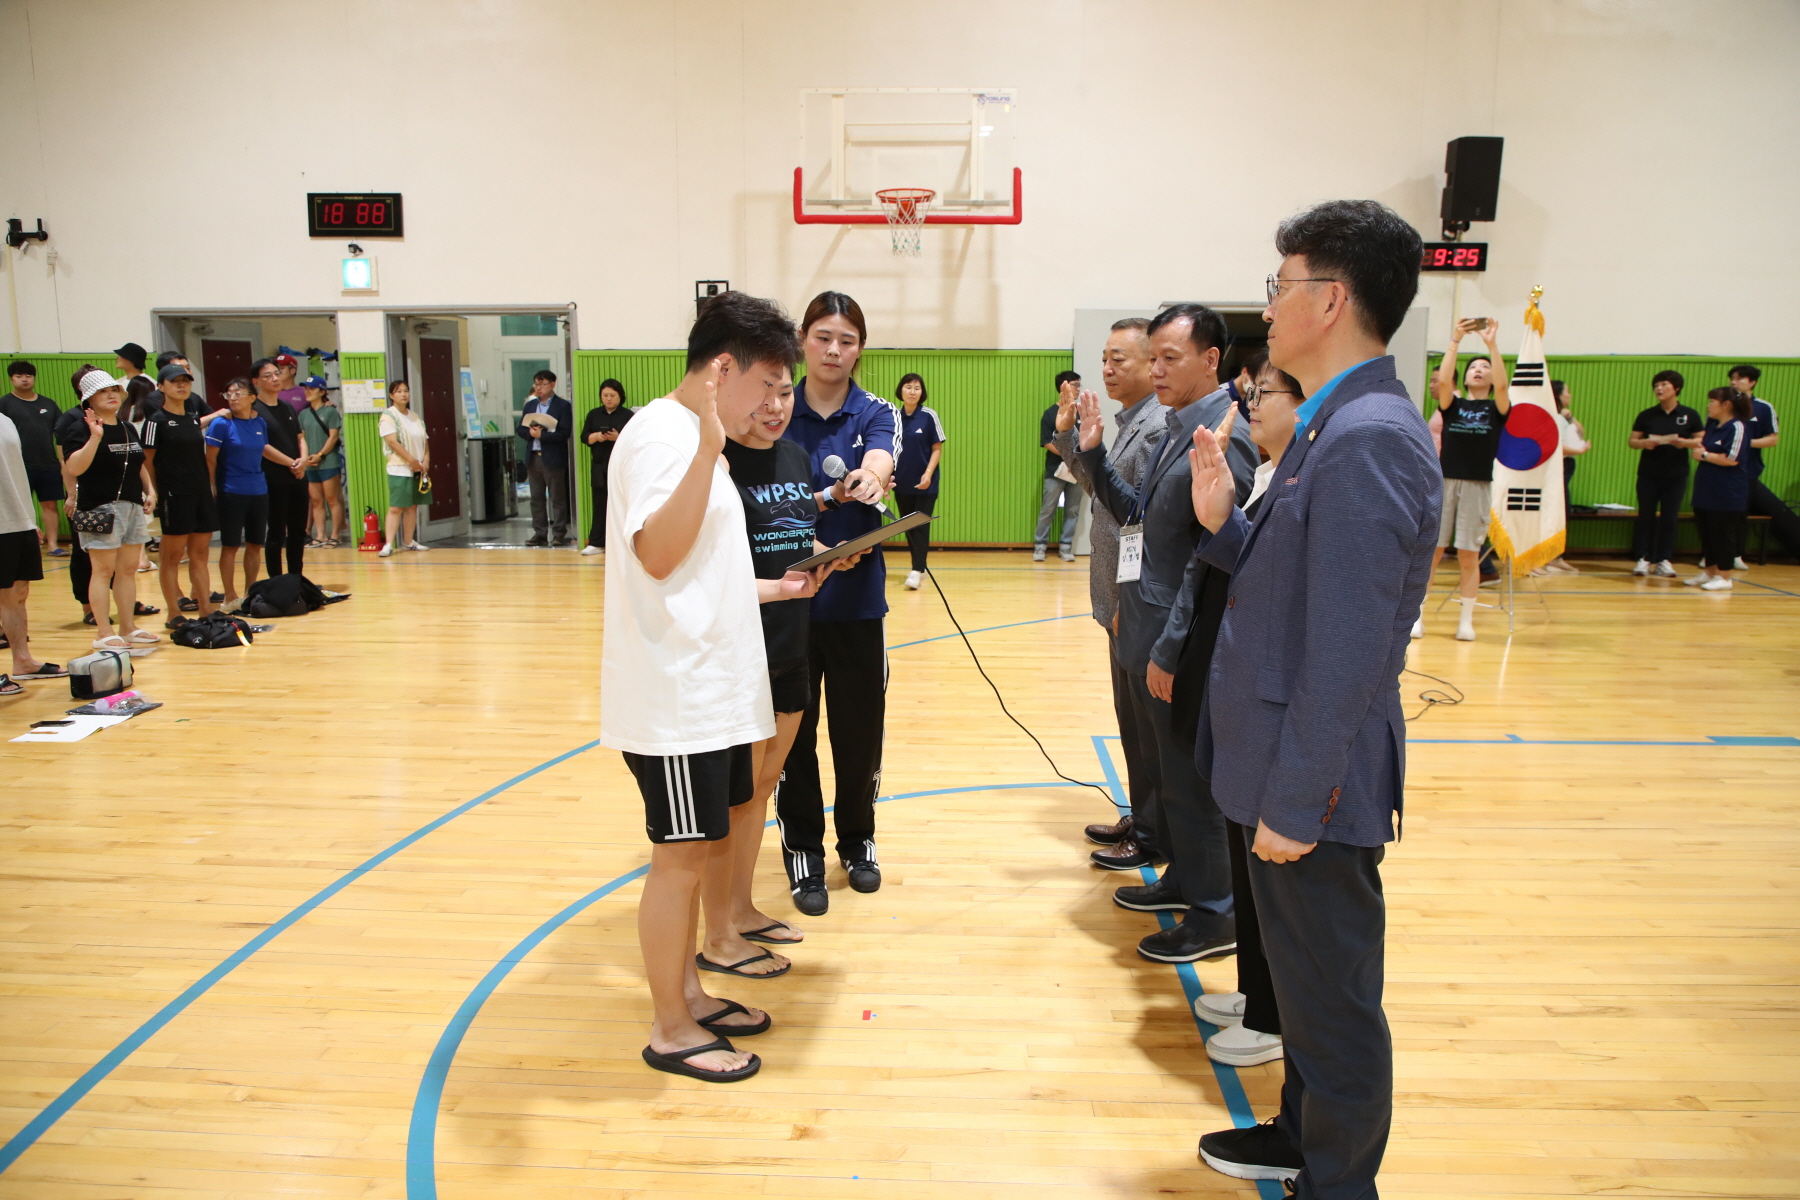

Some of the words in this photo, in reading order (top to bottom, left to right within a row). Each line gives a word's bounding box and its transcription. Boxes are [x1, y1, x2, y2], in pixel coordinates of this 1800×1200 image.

[747, 482, 813, 504] WPSC
[753, 528, 816, 541] WONDERPO
[754, 541, 799, 553] swimming
[802, 538, 814, 548] clu
